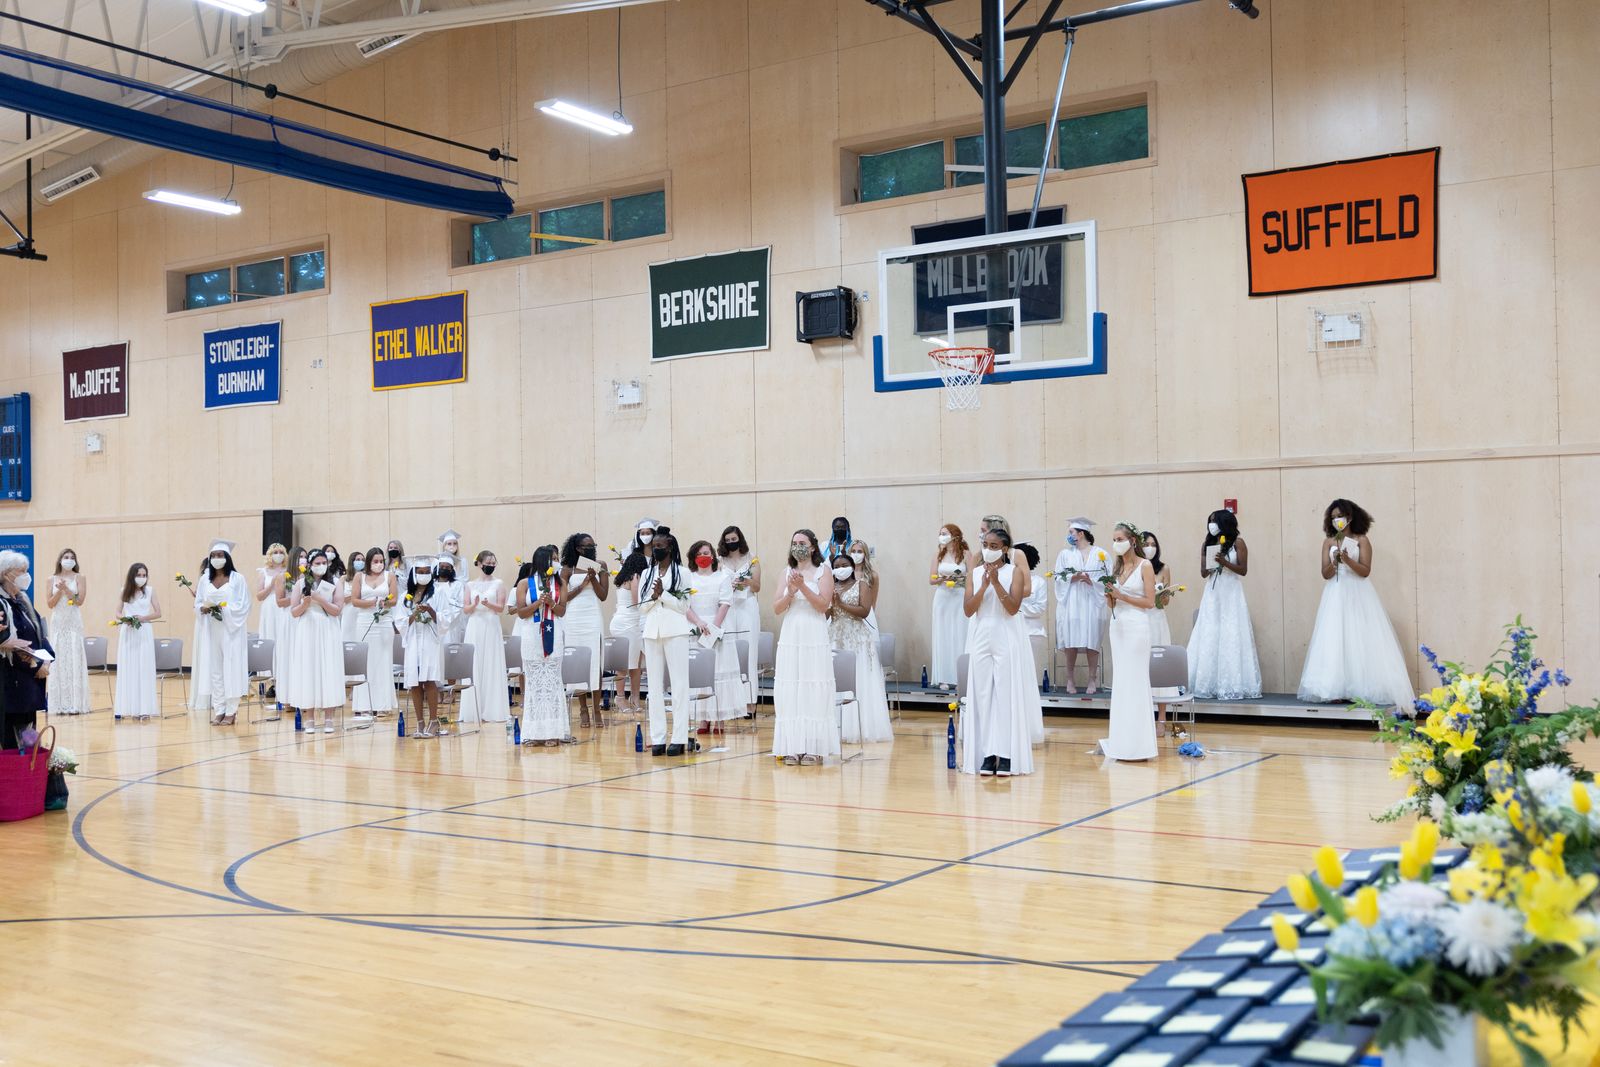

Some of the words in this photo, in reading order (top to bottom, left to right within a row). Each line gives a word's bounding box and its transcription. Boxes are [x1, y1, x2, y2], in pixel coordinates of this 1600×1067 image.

[1262, 194, 1419, 254] SUFFIELD
[926, 245, 1049, 298] MILLBOOK
[659, 280, 760, 328] BERKSHIRE
[209, 335, 274, 364] STONELEIGH-
[374, 327, 413, 362] ETHEL
[415, 321, 463, 357] WALKER
[218, 368, 265, 395] BURNHAM
[2, 425, 18, 433] GUES
